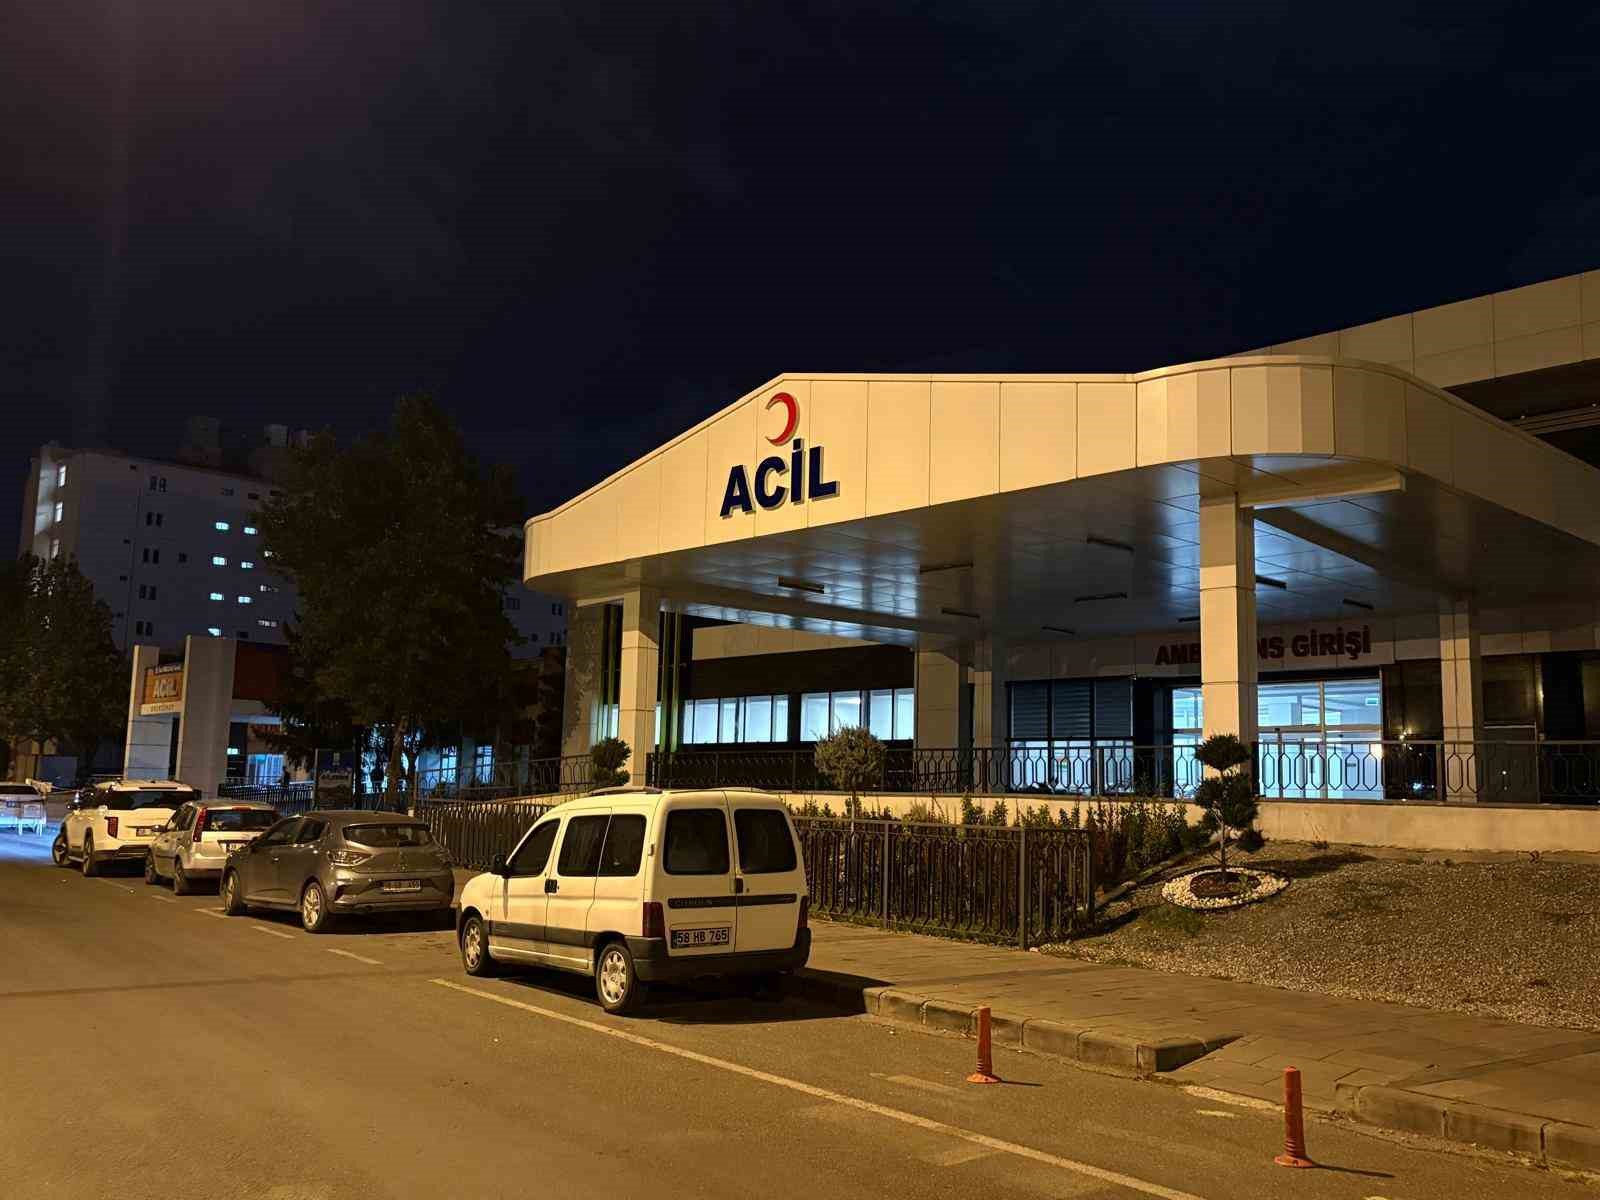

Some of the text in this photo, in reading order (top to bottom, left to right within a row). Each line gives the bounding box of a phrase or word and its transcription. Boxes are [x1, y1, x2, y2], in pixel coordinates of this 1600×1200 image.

[720, 438, 839, 518] ACİL
[1155, 625, 1372, 666] AMBNS GİRİŞİ
[677, 932, 690, 943] 58
